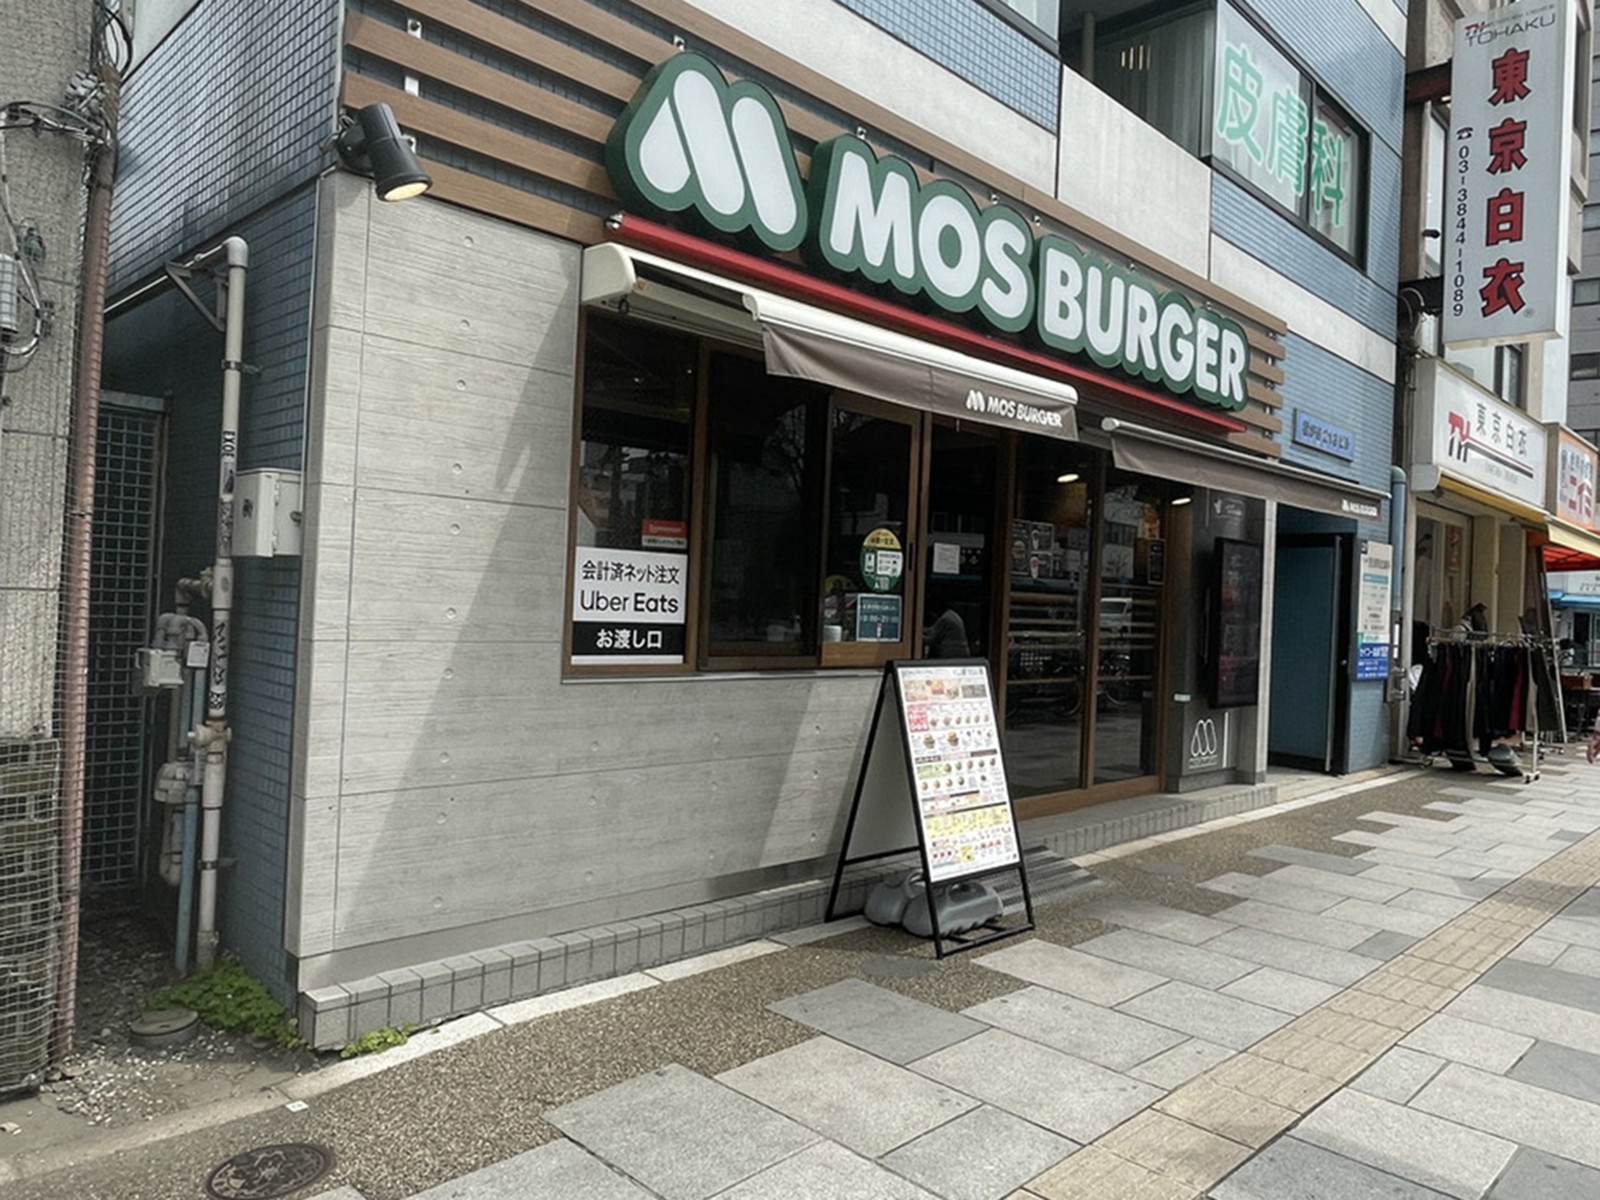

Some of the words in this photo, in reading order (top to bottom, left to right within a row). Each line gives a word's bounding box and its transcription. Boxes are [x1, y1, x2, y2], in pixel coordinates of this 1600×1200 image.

[1465, 13, 1556, 48] TOHAKU
[1215, 42, 1344, 229] 皮膚科
[1479, 47, 1532, 318] 東京白衣
[829, 150, 1030, 320] MOS
[1043, 247, 1245, 405] BURGER
[987, 396, 1016, 419] MOS
[1016, 403, 1064, 428] BURGER
[1475, 402, 1528, 457] 東京白衣
[581, 559, 681, 585] 会計済ネット注文
[580, 589, 630, 612] Uber
[633, 592, 679, 613] Eats
[596, 628, 662, 650] お渡し口
